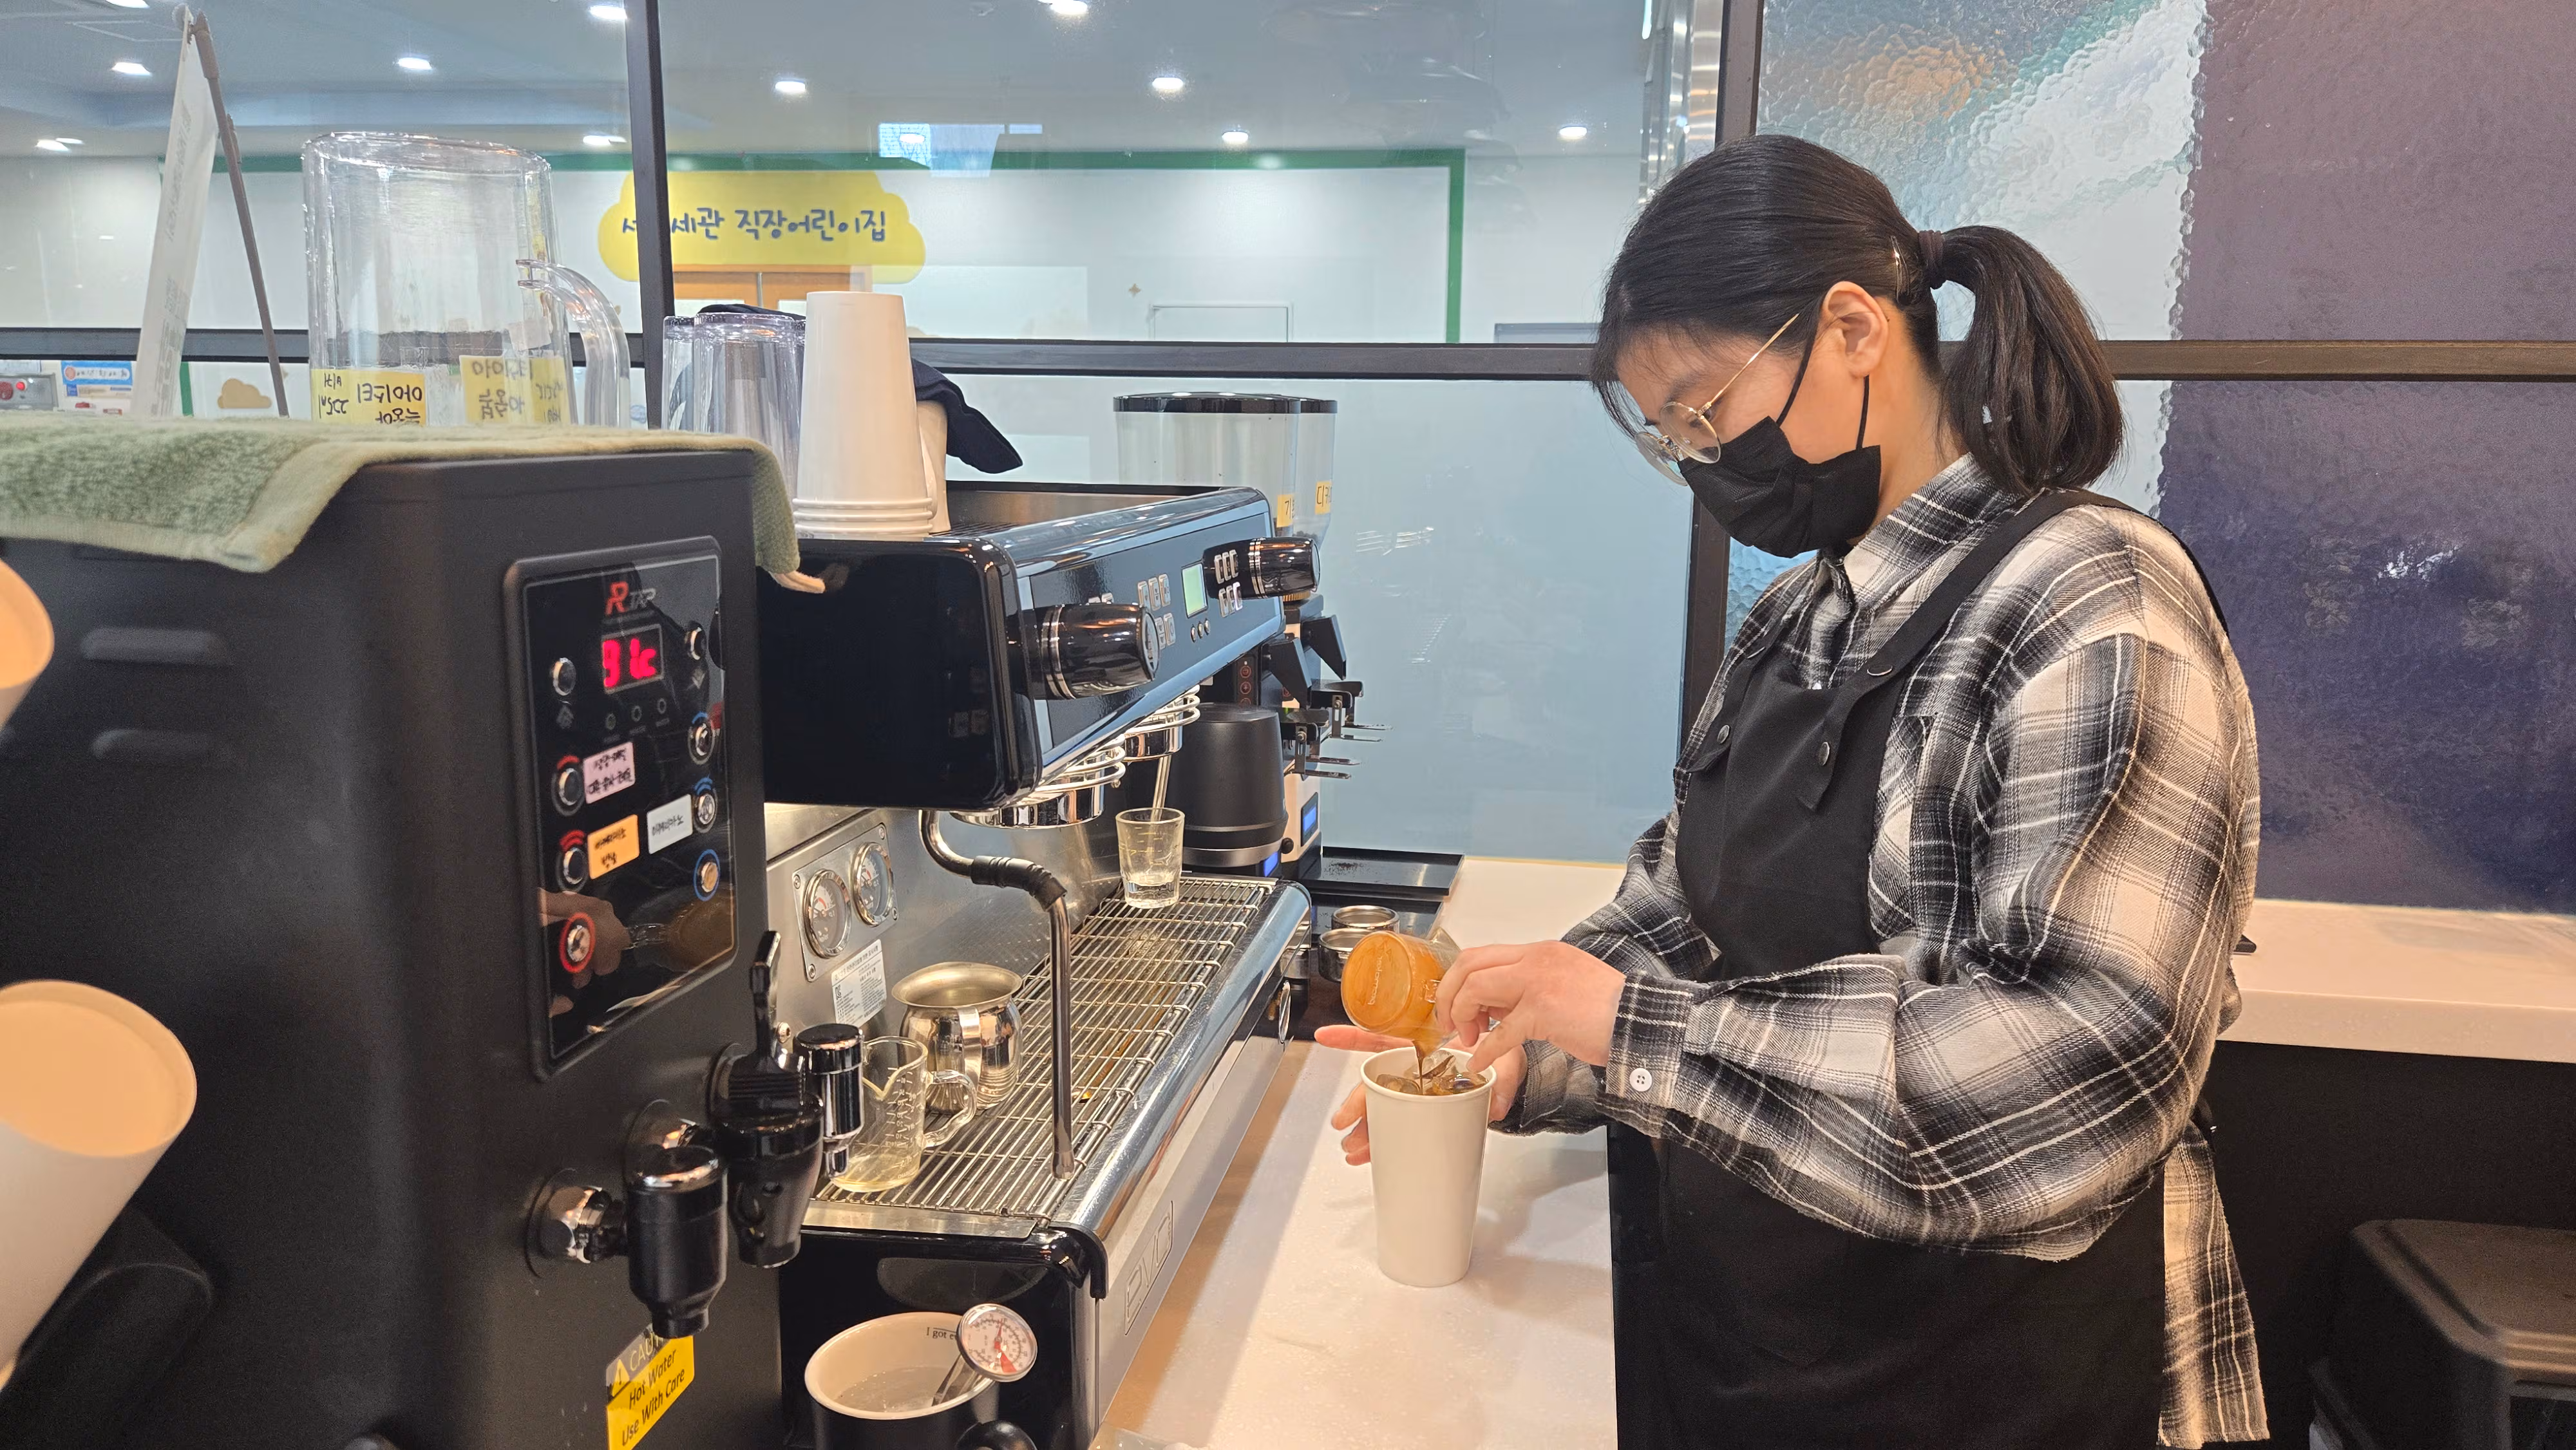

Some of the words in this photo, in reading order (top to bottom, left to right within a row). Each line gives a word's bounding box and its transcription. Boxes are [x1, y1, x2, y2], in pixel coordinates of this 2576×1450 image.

[622, 207, 724, 240] 서세관
[734, 209, 886, 241] 직장어린이집
[357, 382, 423, 404] 아이스티
[630, 1331, 664, 1372] CAUT
[932, 1330, 947, 1339] got
[629, 1380, 646, 1410] Hot
[648, 1349, 677, 1388] Water
[622, 1419, 639, 1447] Use
[641, 1391, 663, 1424] With
[665, 1368, 685, 1398] Care
